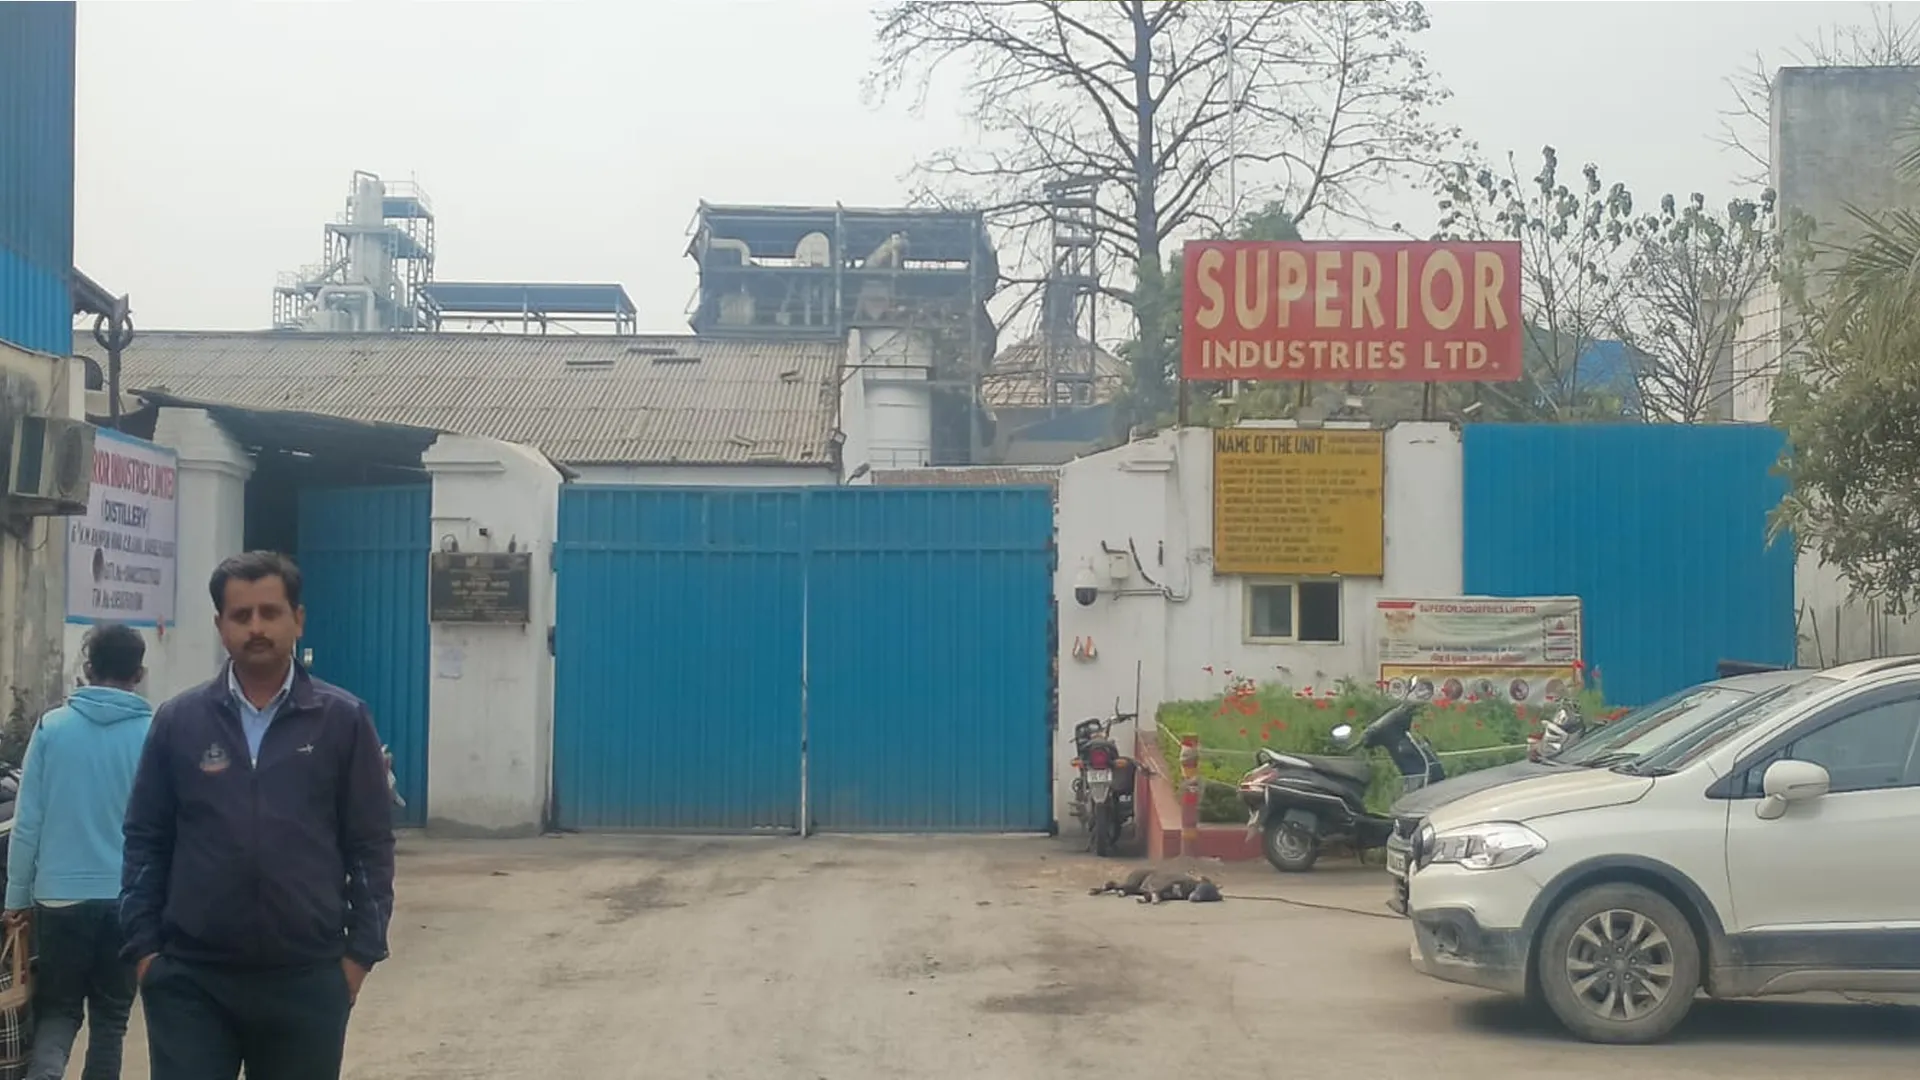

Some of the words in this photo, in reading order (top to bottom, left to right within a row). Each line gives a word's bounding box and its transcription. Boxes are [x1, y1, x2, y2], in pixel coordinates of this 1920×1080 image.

[1196, 248, 1508, 331] SUPERIOR
[1202, 340, 1406, 370] INDUSTRIES
[1424, 341, 1500, 370] LTD.
[1217, 435, 1250, 454] NAME
[1255, 435, 1269, 454] OF
[1271, 435, 1295, 454] THE
[1295, 436, 1323, 454] UNIT
[110, 452, 151, 496] INDUSTRIES
